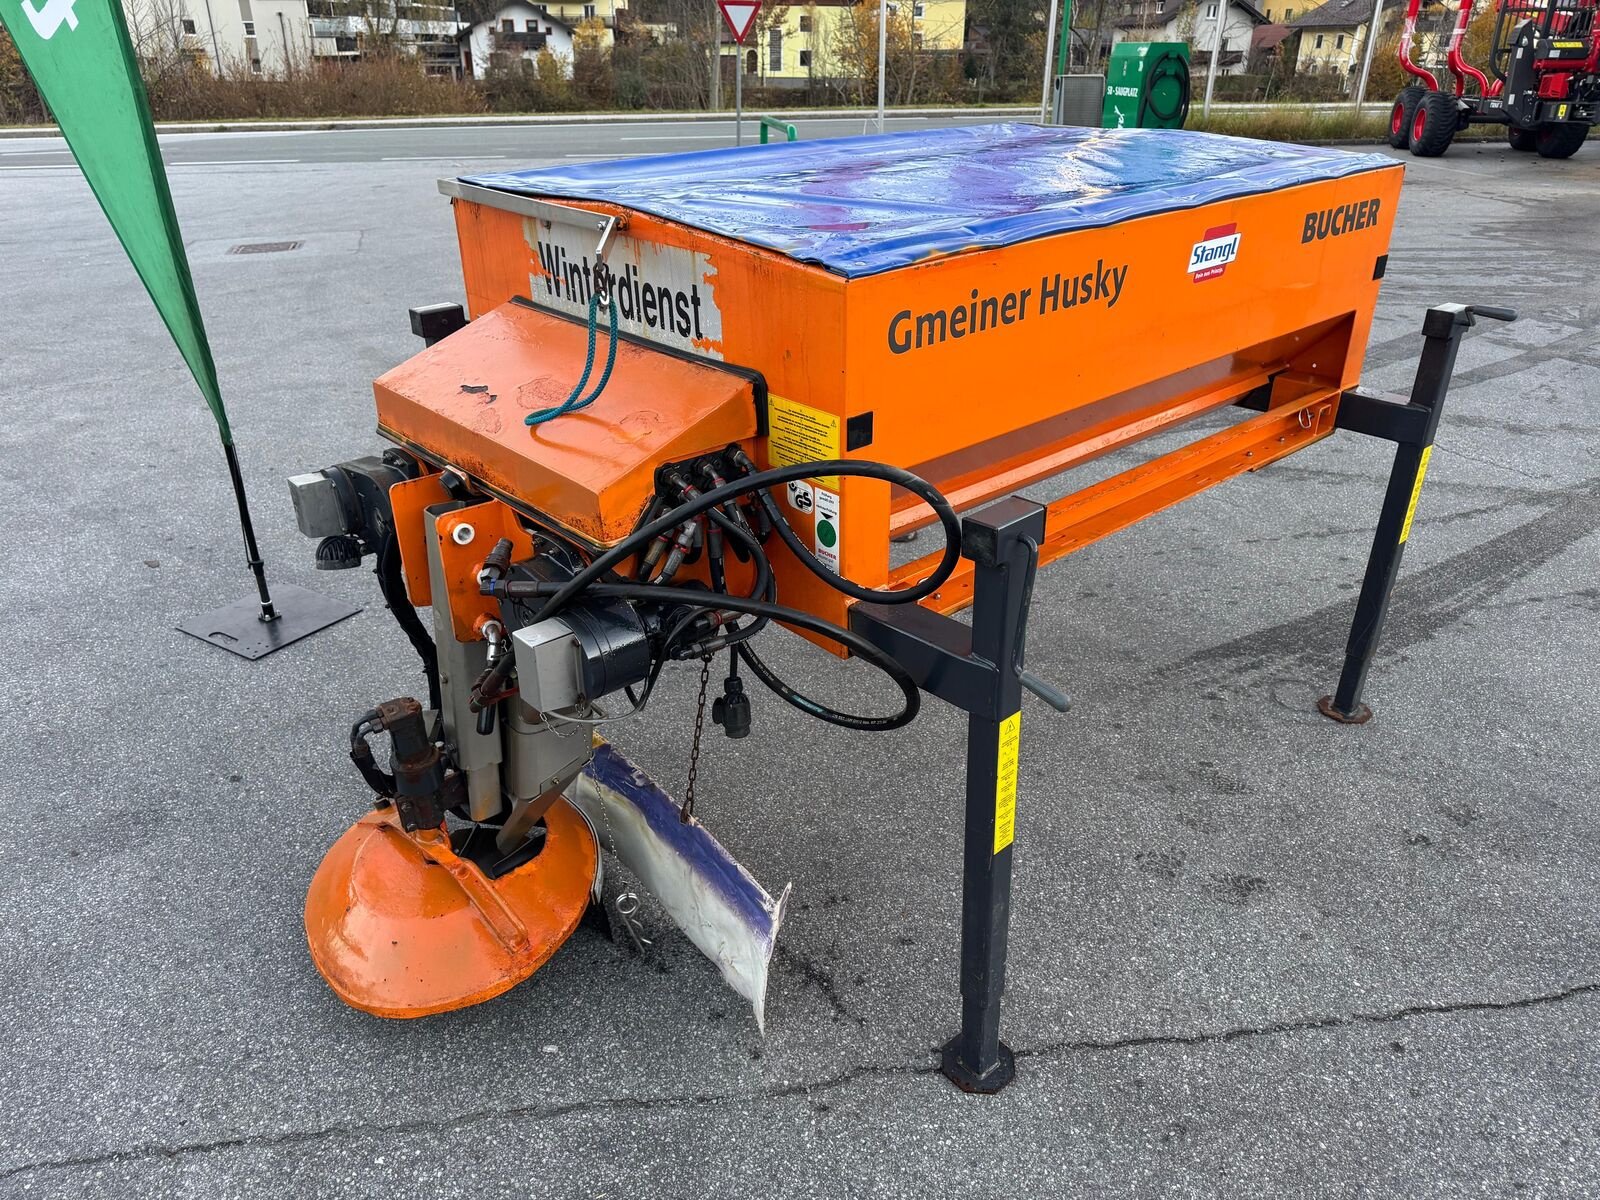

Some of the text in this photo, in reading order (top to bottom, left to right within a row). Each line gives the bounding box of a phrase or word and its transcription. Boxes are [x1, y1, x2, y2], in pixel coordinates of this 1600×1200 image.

[1301, 198, 1381, 244] BUCHER
[1191, 237, 1238, 266] Stangl
[537, 241, 703, 340] Wintrdienst
[887, 258, 1129, 355] Gmeiner Husky
[795, 491, 812, 509] GS
[818, 548, 837, 560] BUCHER
